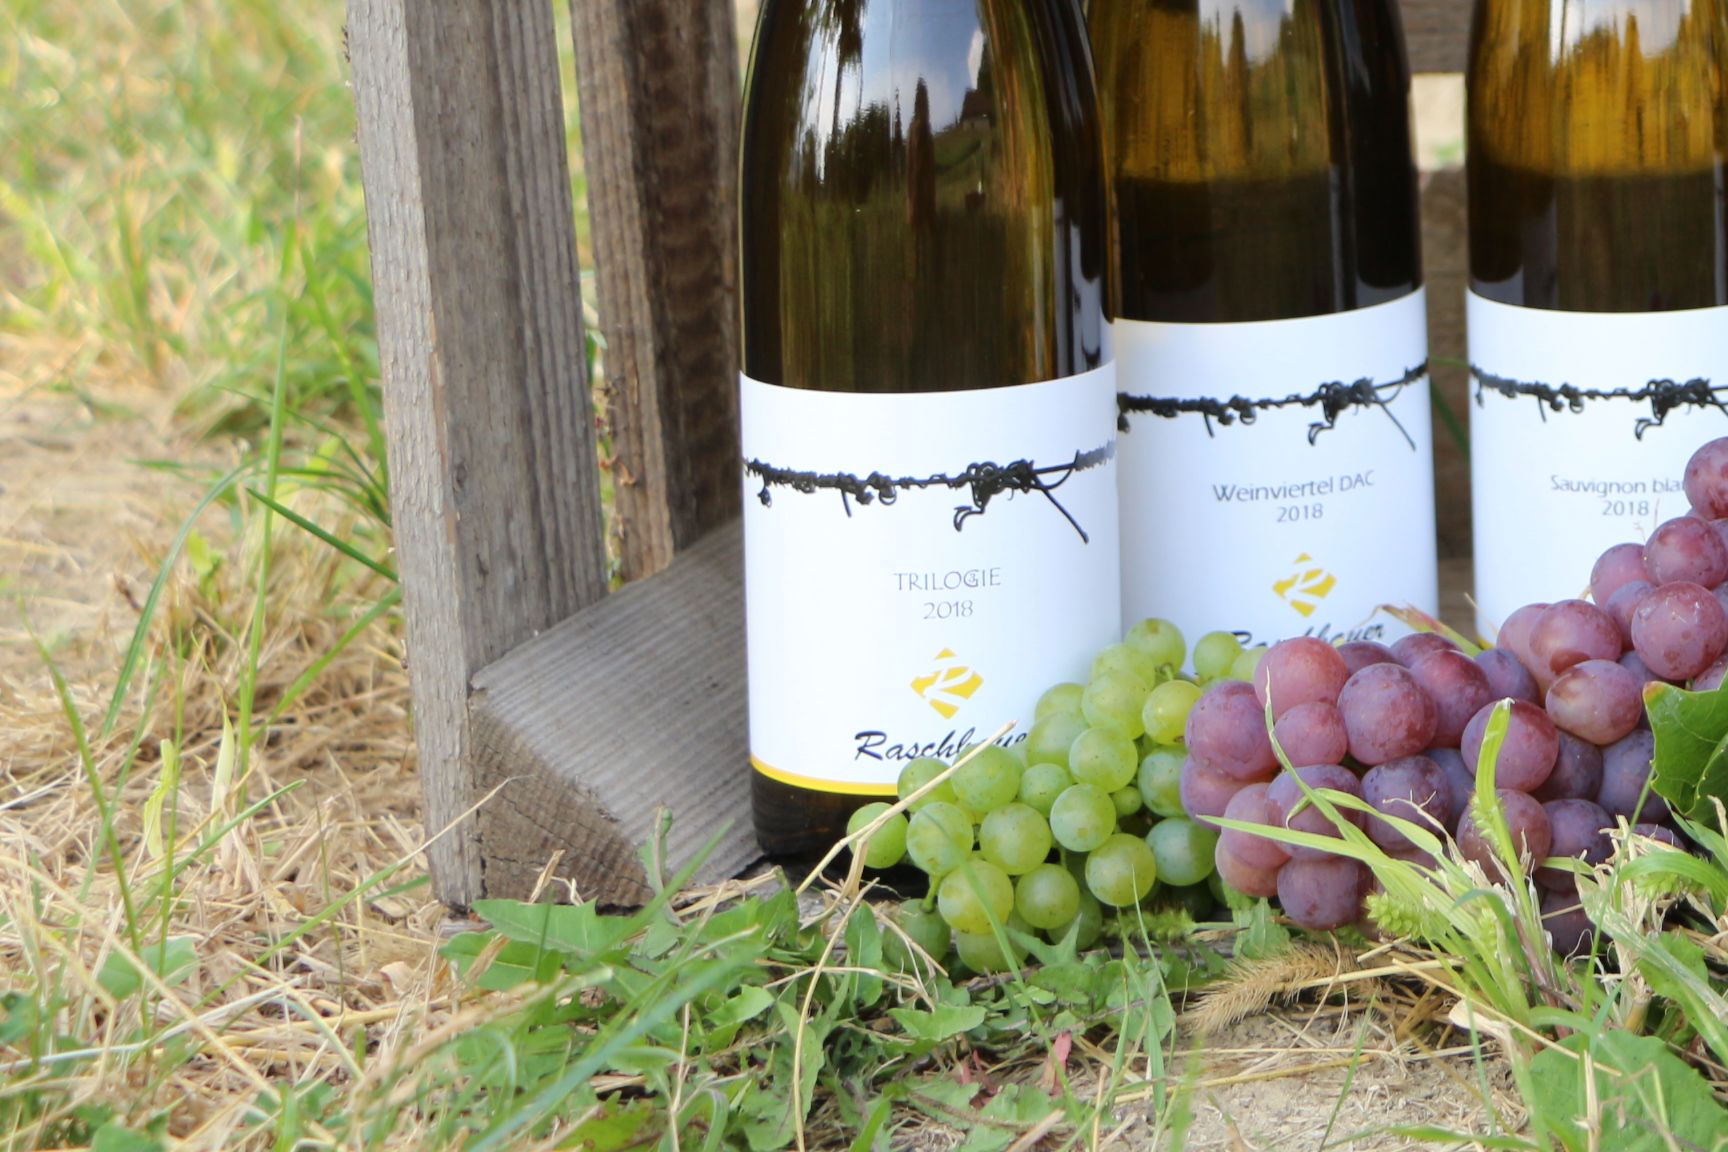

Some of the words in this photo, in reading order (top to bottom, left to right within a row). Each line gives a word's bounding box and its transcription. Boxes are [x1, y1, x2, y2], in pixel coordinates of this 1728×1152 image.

[1212, 476, 1334, 502] Weinviertel
[1339, 469, 1375, 492] DAC
[1550, 474, 1647, 498] Sauvignon
[1652, 478, 1686, 494] bla
[1276, 502, 1324, 523] 2018
[1602, 500, 1649, 517] 2018
[893, 566, 1001, 591] TRILOGIE
[923, 599, 974, 620] 2018
